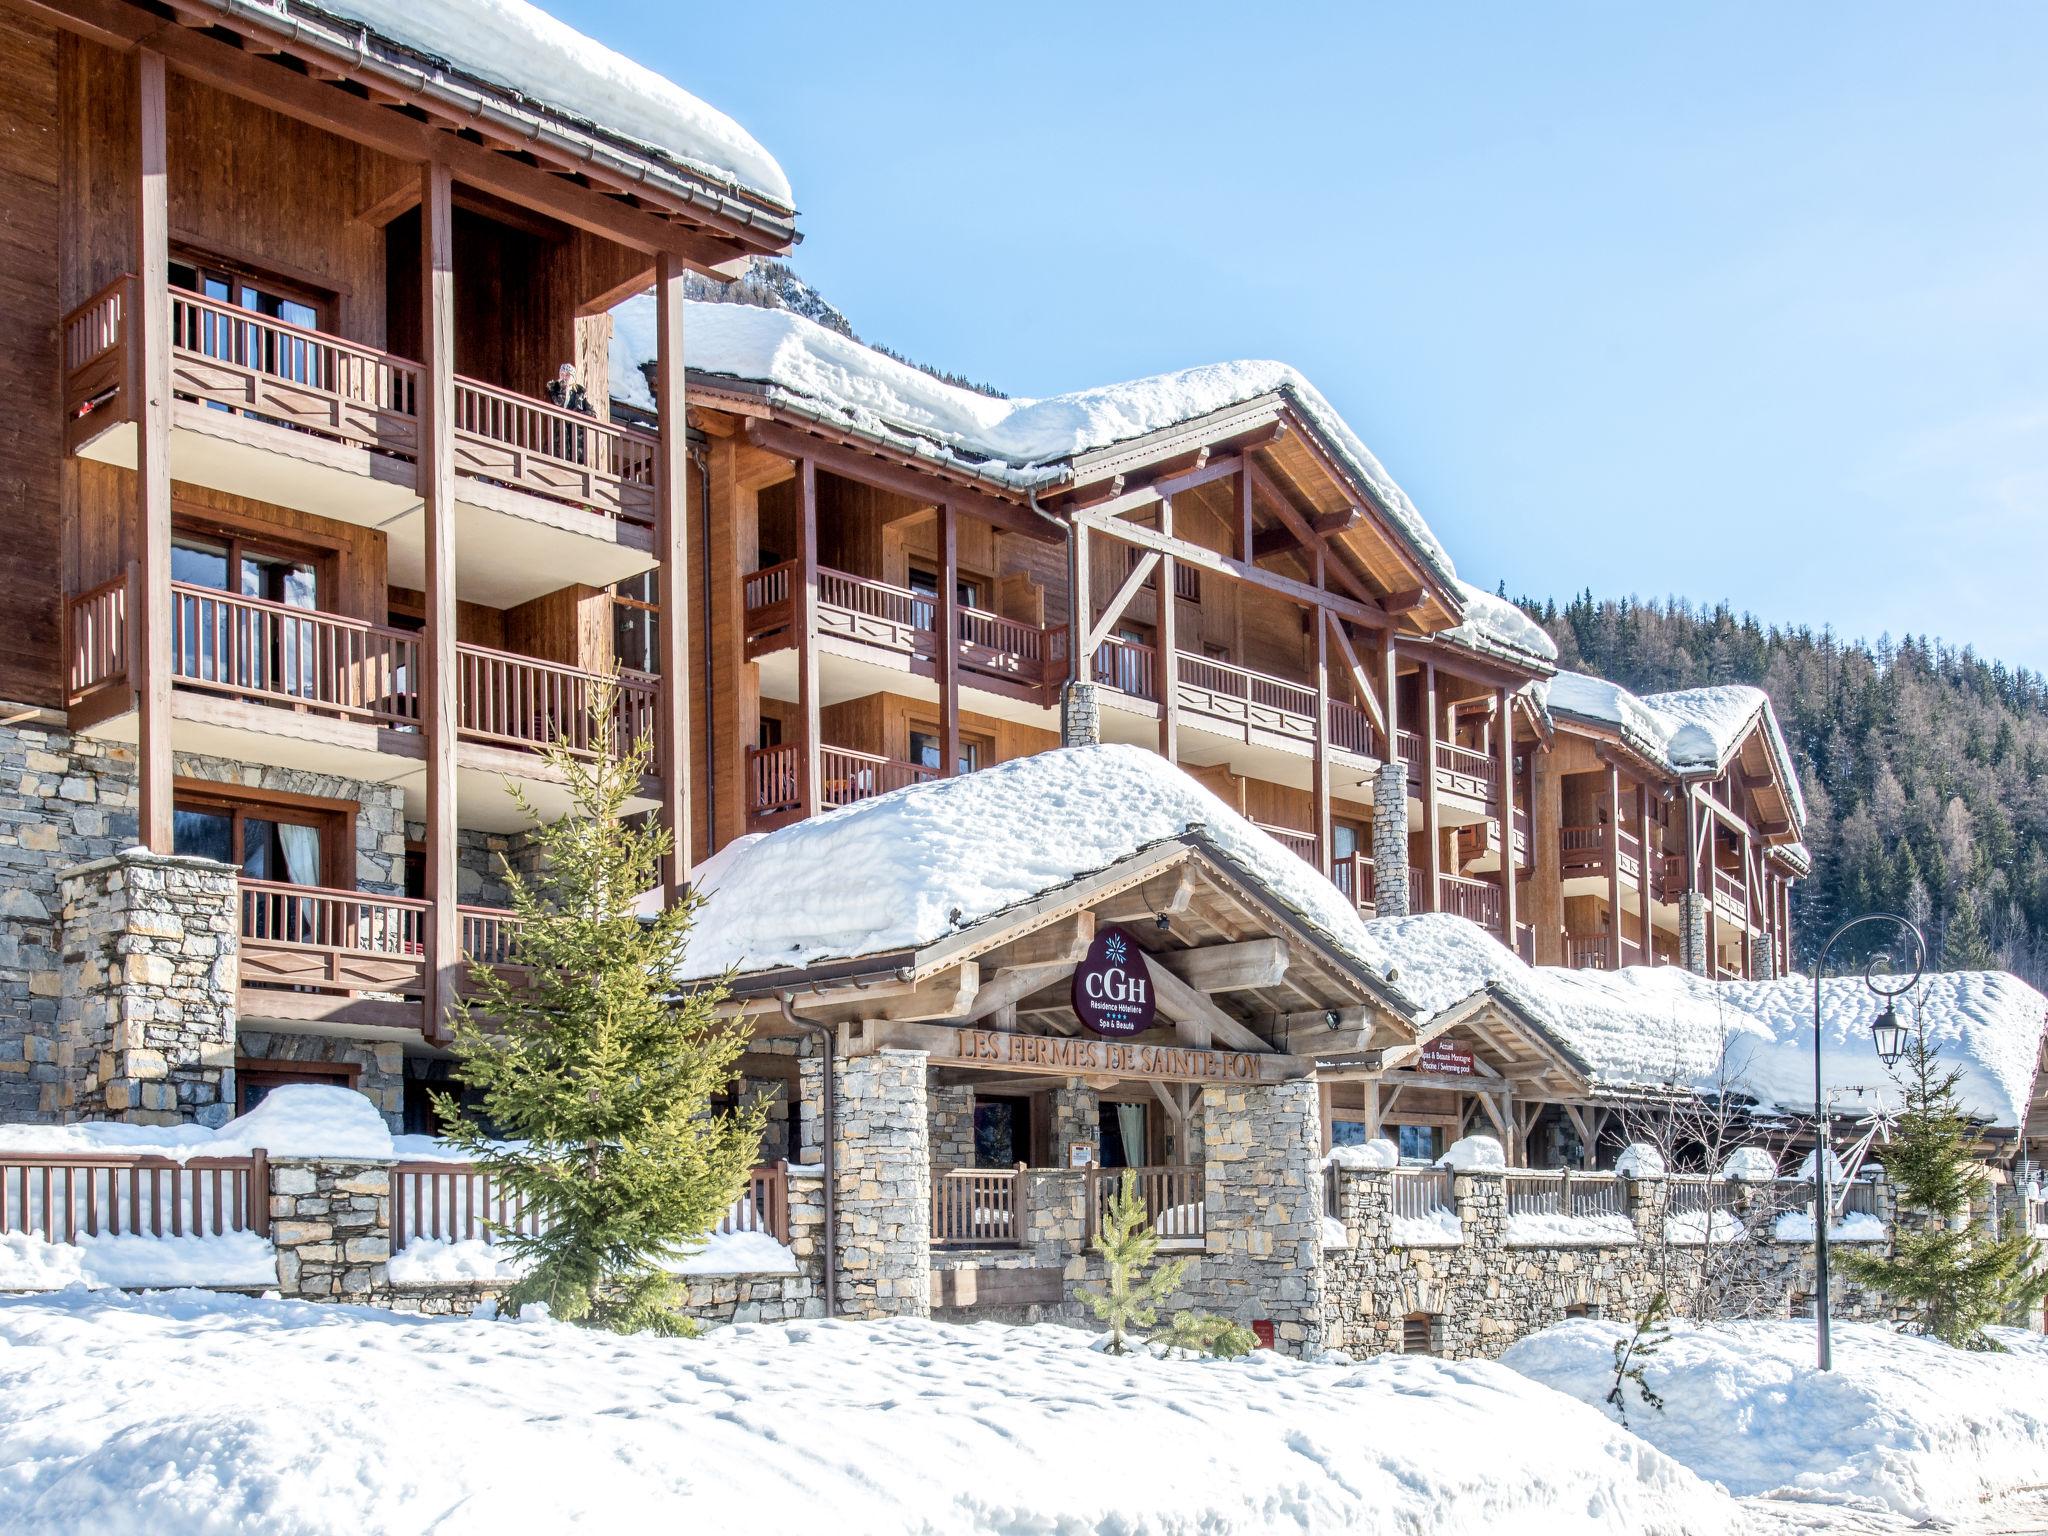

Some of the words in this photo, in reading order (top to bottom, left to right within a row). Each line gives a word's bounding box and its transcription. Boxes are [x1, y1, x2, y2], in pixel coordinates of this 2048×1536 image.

[1085, 968, 1146, 1003] CGH
[1090, 1000, 1117, 1011] Résidence
[1118, 1003, 1142, 1014] Hôtelière
[1099, 1018, 1110, 1028] Spa
[1111, 1020, 1115, 1028] &
[1116, 1020, 1134, 1030] Beauté
[1438, 1042, 1454, 1050] Accueil
[958, 1029, 1000, 1061] LES
[1008, 1034, 1100, 1068] FERMES
[1105, 1044, 1136, 1071] DE
[1141, 1046, 1263, 1079] SAINTE-FOY
[1422, 1061, 1437, 1069] Piscine
[1440, 1062, 1460, 1074] Swimming
[1460, 1065, 1470, 1074] pool
